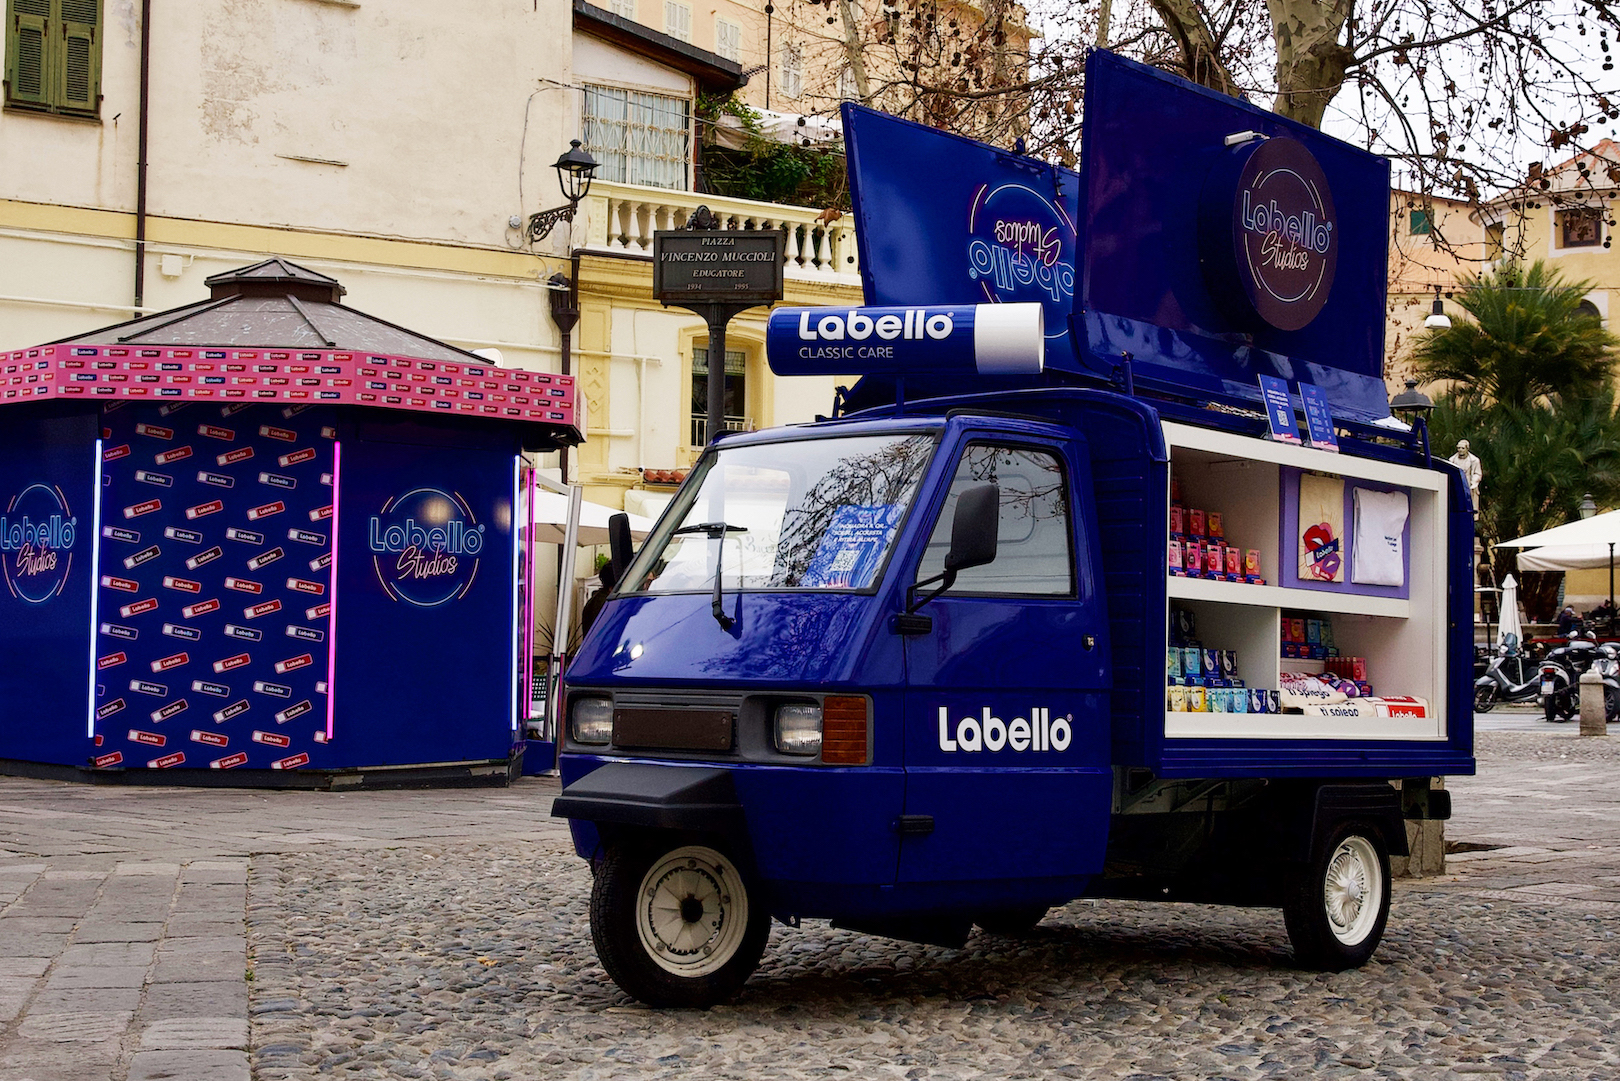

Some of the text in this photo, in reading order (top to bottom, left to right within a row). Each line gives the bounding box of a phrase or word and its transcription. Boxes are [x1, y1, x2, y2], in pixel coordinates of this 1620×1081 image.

[1242, 190, 1330, 254] Labello
[661, 252, 776, 262] VINCENZO MUCCIOLI
[702, 238, 734, 246] PIAZZA
[1261, 230, 1310, 270] Studios
[692, 269, 745, 278] EDUCATORE
[969, 240, 1075, 302] abello
[799, 310, 954, 340] Labello
[799, 346, 894, 358] CLASSIC CARE
[0, 514, 76, 550] Labello
[370, 516, 482, 554] Labello
[16, 542, 58, 578] Studios
[396, 546, 458, 580] Studios
[938, 706, 1072, 752] Labello
